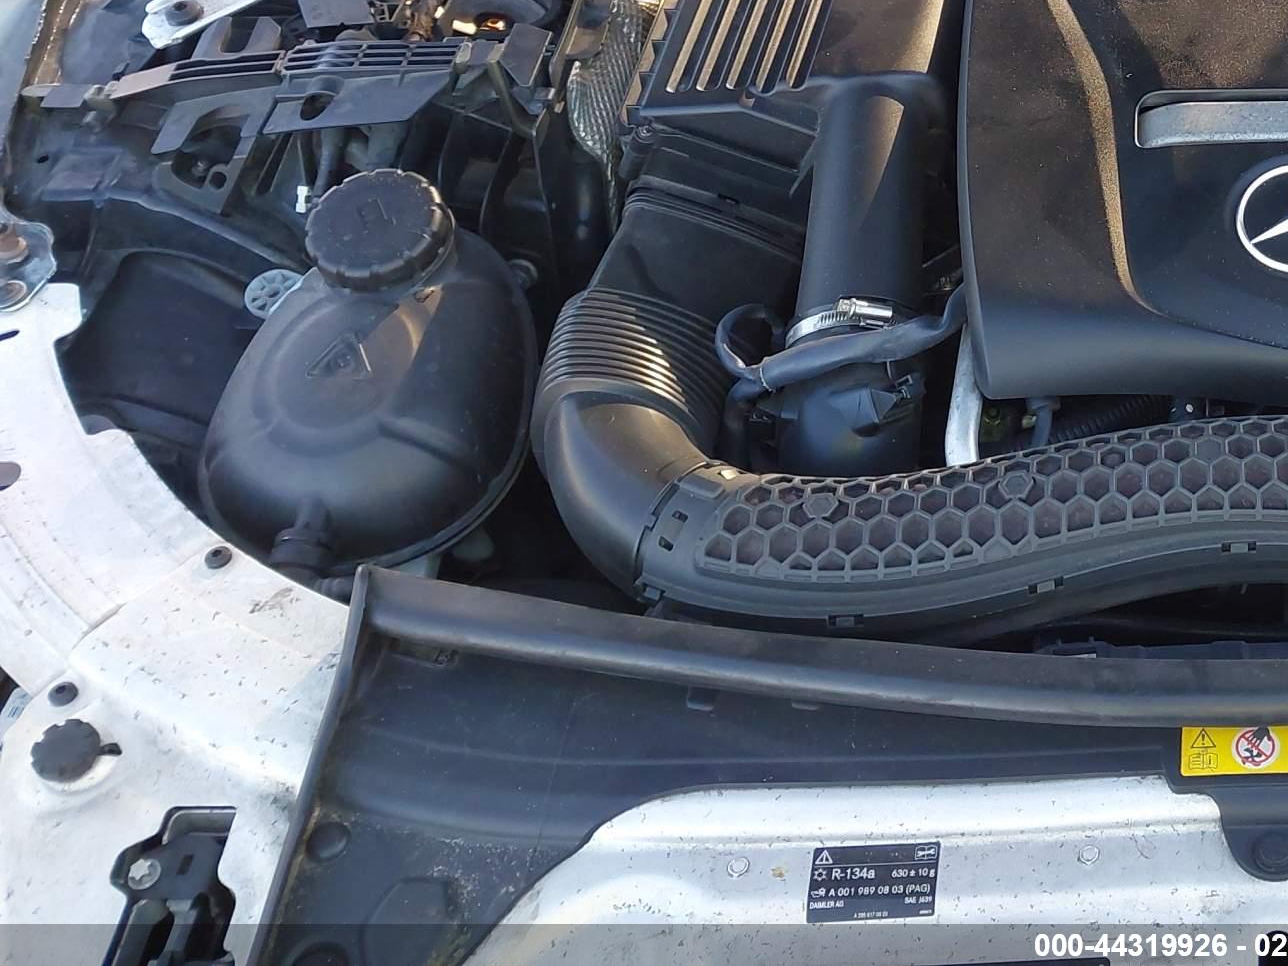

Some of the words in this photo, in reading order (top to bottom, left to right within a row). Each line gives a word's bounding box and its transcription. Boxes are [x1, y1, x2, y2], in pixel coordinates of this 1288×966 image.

[831, 867, 876, 880] R-134a
[891, 869, 908, 878] 630
[918, 868, 928, 877] 10
[828, 889, 836, 897] A
[837, 888, 855, 897] 001
[858, 886, 875, 896] 989
[877, 885, 889, 895] 08
[891, 884, 904, 894] 03
[905, 884, 931, 895] (PAG)
